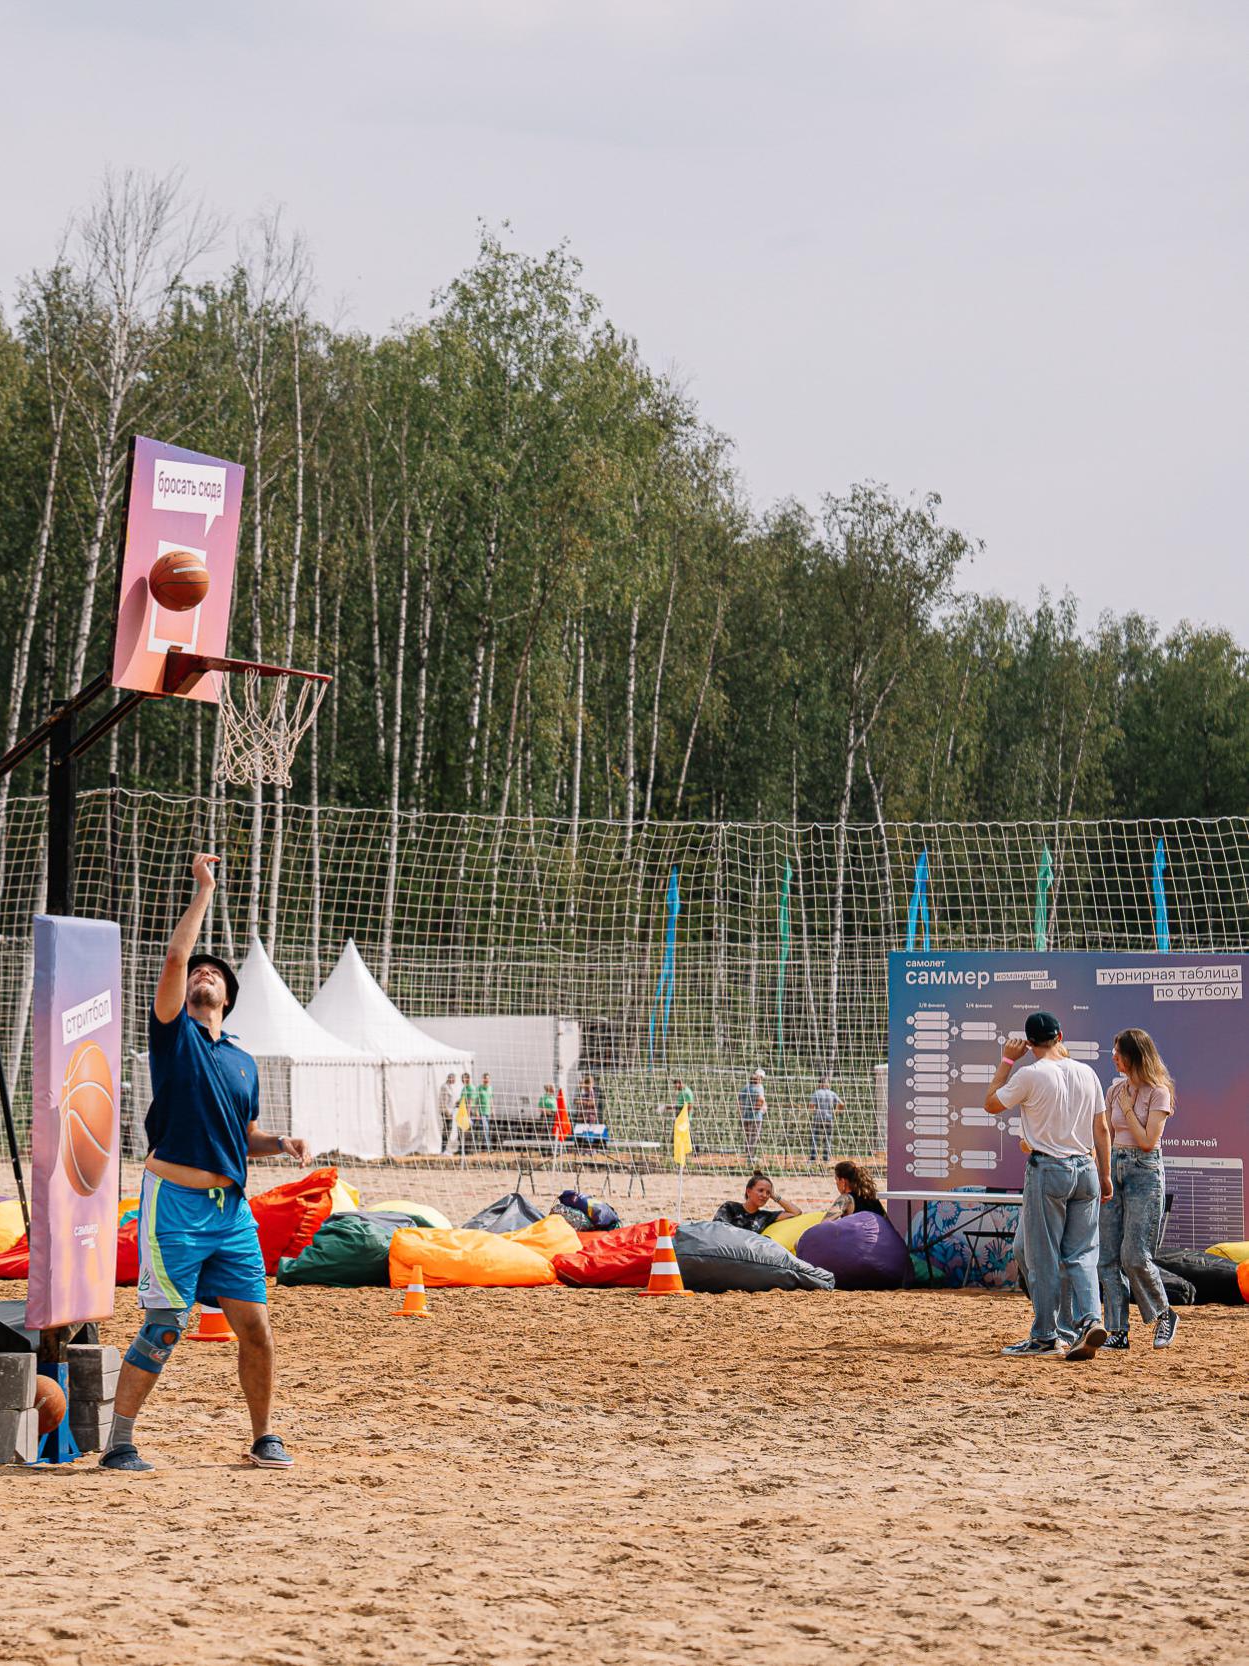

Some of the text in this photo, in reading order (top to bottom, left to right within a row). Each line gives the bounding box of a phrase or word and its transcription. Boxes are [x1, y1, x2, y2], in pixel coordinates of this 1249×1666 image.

[158, 470, 222, 502] бросать сюда
[905, 959, 946, 968] самолет
[905, 970, 990, 990] саммер
[1100, 967, 1239, 984] турнирная таблица
[1156, 984, 1239, 1000] по футболу
[66, 999, 109, 1035] стритбол
[1181, 1138, 1218, 1148] матчей
